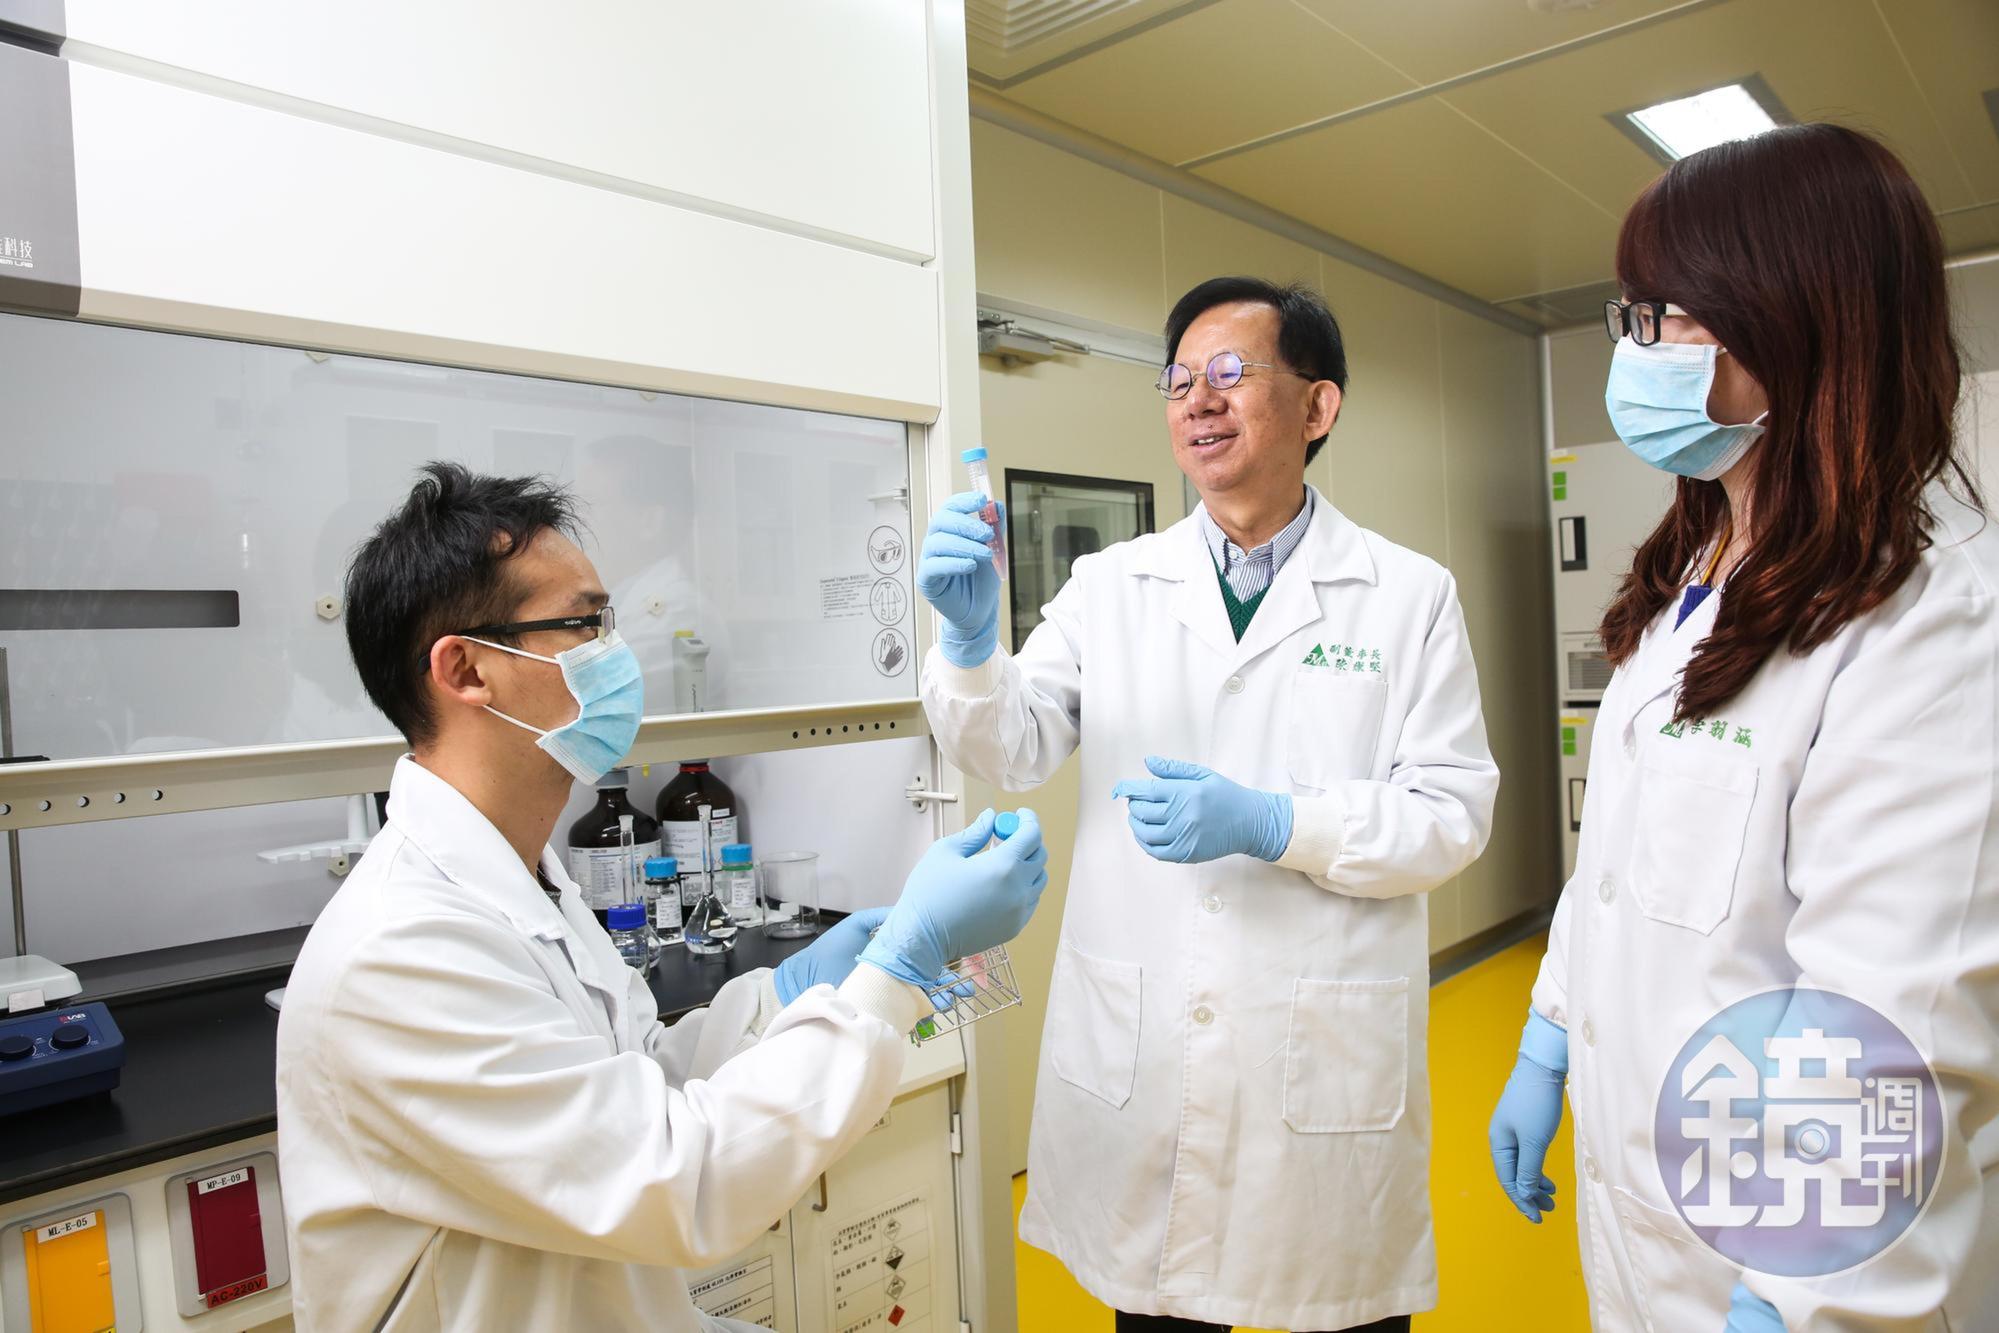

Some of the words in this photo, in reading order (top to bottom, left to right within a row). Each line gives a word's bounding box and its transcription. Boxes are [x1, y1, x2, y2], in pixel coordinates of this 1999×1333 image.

[206, 1173, 241, 1190] MP-E-09
[48, 1217, 88, 1237] ML-E-05
[210, 1279, 263, 1305] AC-220V
